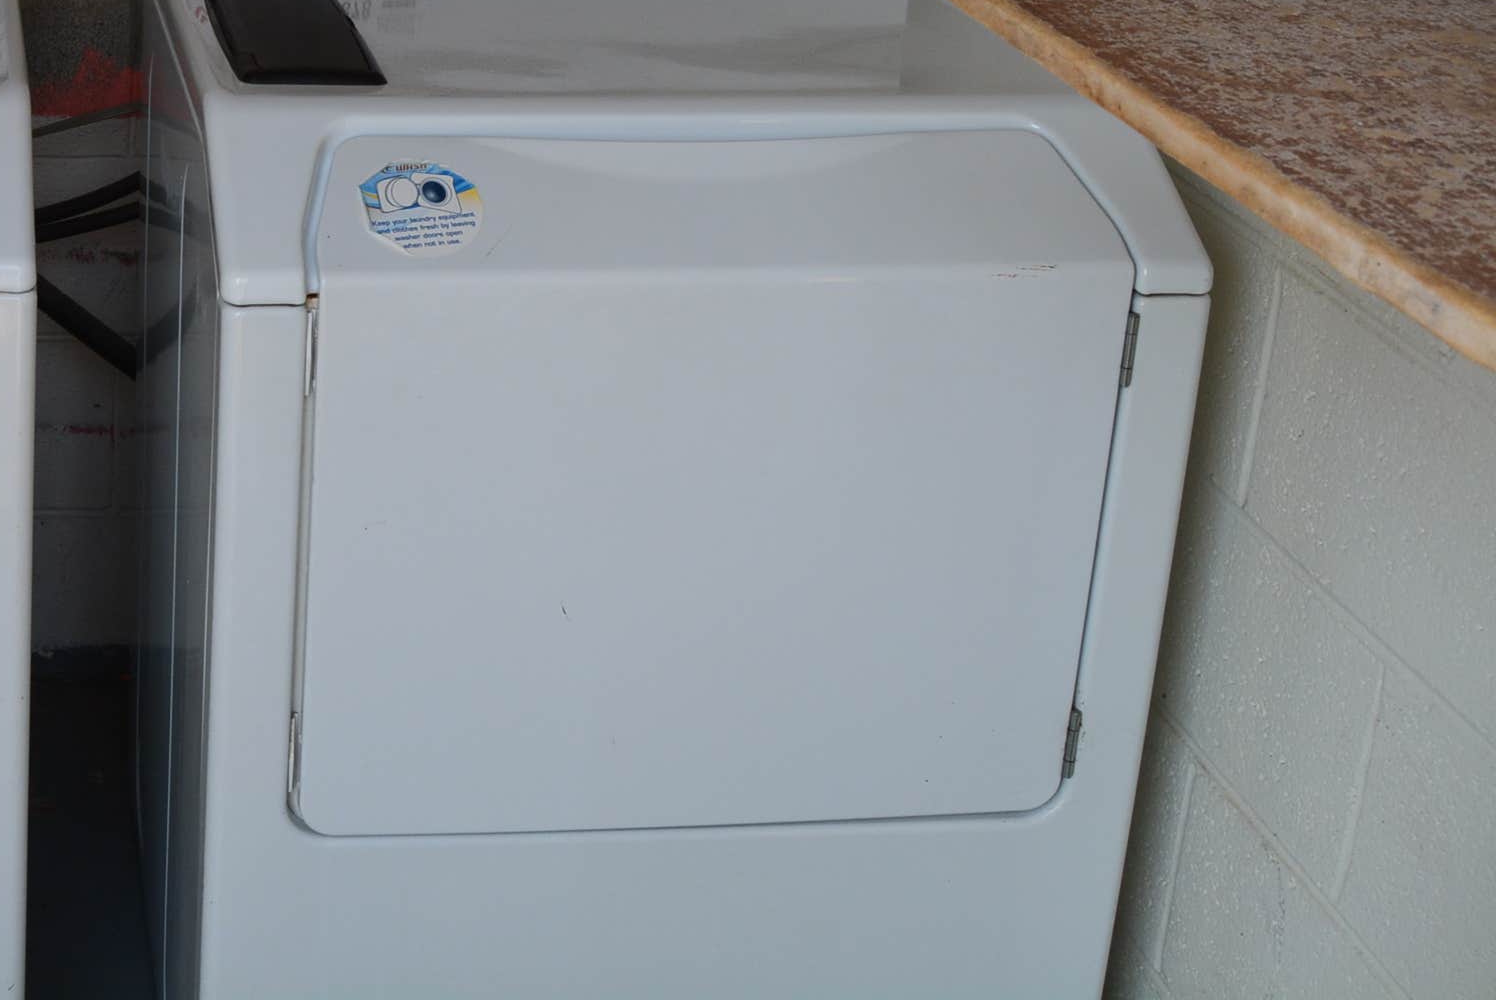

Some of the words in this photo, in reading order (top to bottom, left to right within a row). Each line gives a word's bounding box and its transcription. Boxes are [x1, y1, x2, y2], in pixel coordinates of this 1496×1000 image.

[409, 215, 437, 224] laundry
[395, 233, 421, 241] washer
[446, 230, 464, 238] open
